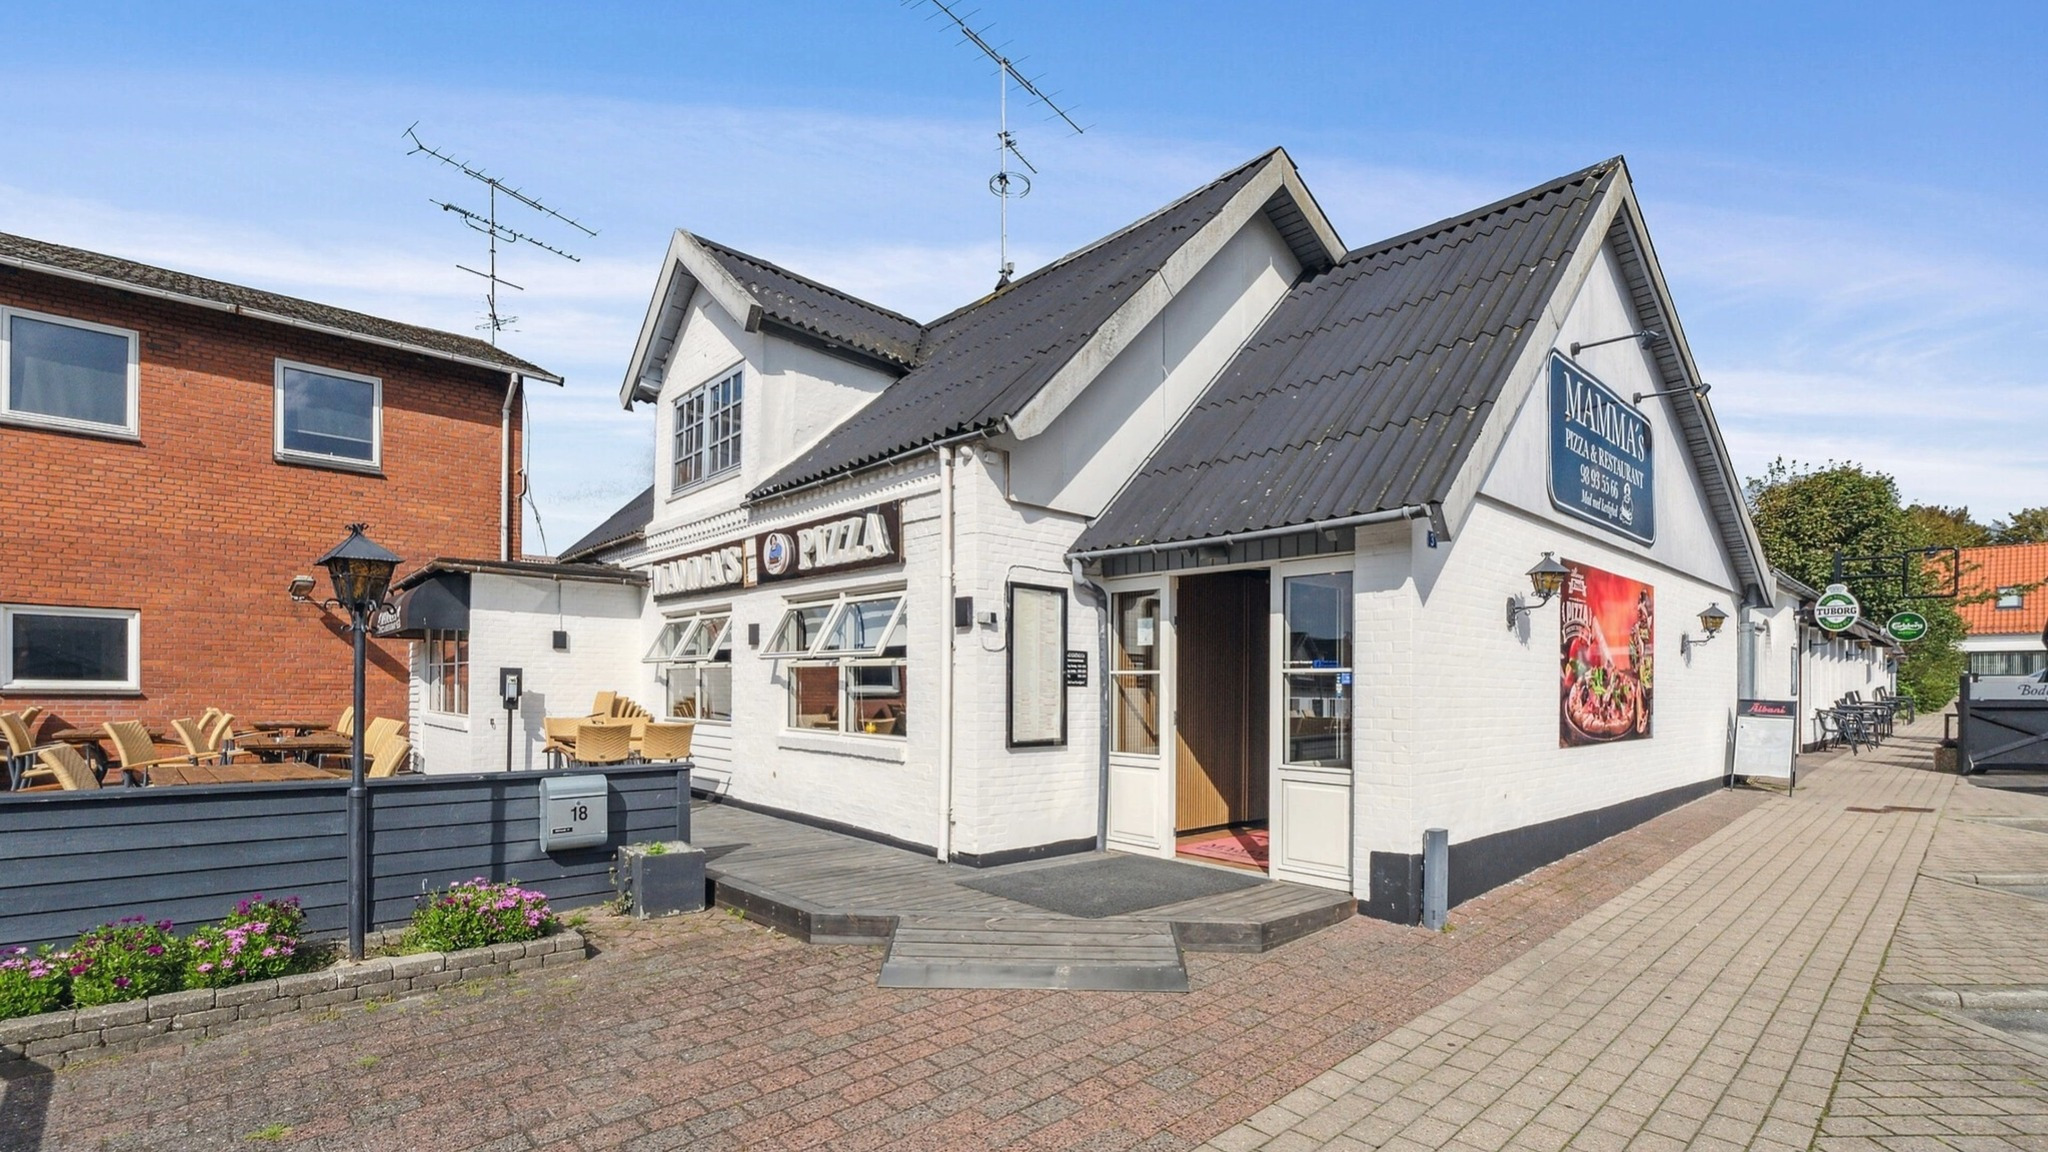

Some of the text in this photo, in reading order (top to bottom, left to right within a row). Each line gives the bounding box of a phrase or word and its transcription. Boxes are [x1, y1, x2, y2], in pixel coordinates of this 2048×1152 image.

[1565, 427, 1645, 489] PIZZA & RESTAURANT
[1580, 463, 1590, 485] 98
[1590, 469, 1600, 490] 93
[1601, 474, 1610, 495] 55
[797, 513, 889, 569] PIZZA
[1816, 606, 1857, 616] TUBORG
[570, 805, 588, 822] 18
